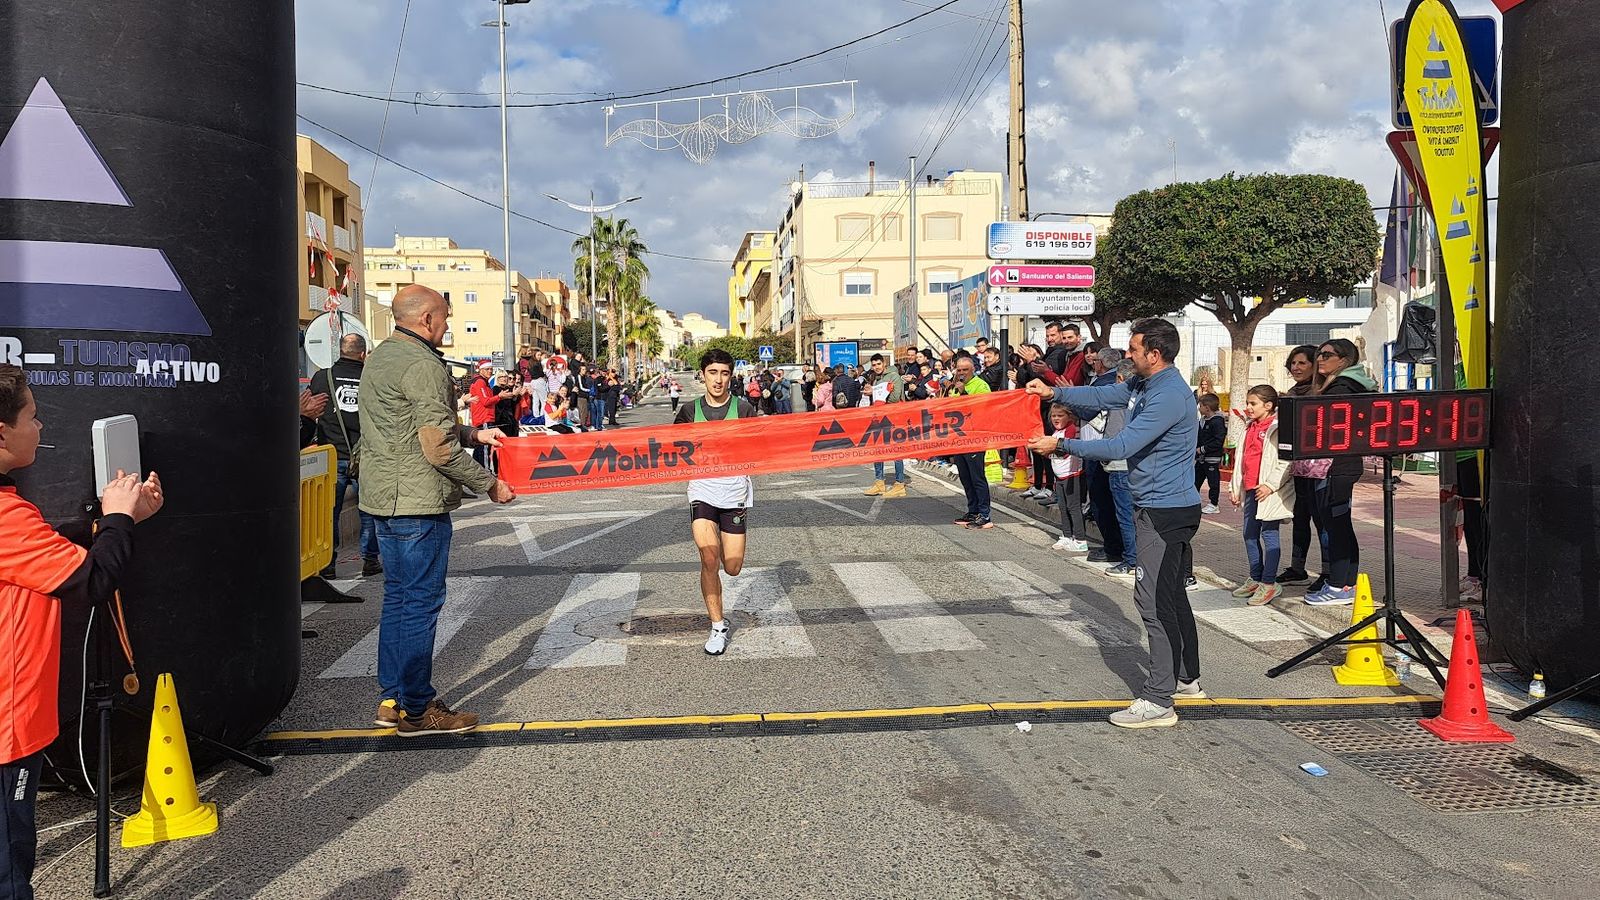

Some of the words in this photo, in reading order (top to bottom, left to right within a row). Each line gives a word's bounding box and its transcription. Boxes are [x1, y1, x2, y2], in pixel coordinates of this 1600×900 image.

[1026, 231, 1092, 240] DISPONIBLE
[1071, 241, 1092, 249] 907
[1036, 295, 1091, 303] ayuntamiento
[59, 339, 191, 368] TURISMO
[74, 371, 94, 386] DE
[135, 359, 220, 383] ACTIVO
[811, 451, 850, 462] EVENTOS
[912, 441, 948, 451] TURISMO
[530, 479, 571, 490] EVENTOS
[574, 474, 631, 486] DEPORTIVOS
[640, 469, 678, 480] TURISMO
[680, 466, 711, 476] ACTIVO
[713, 462, 756, 473] OUTDOOR
